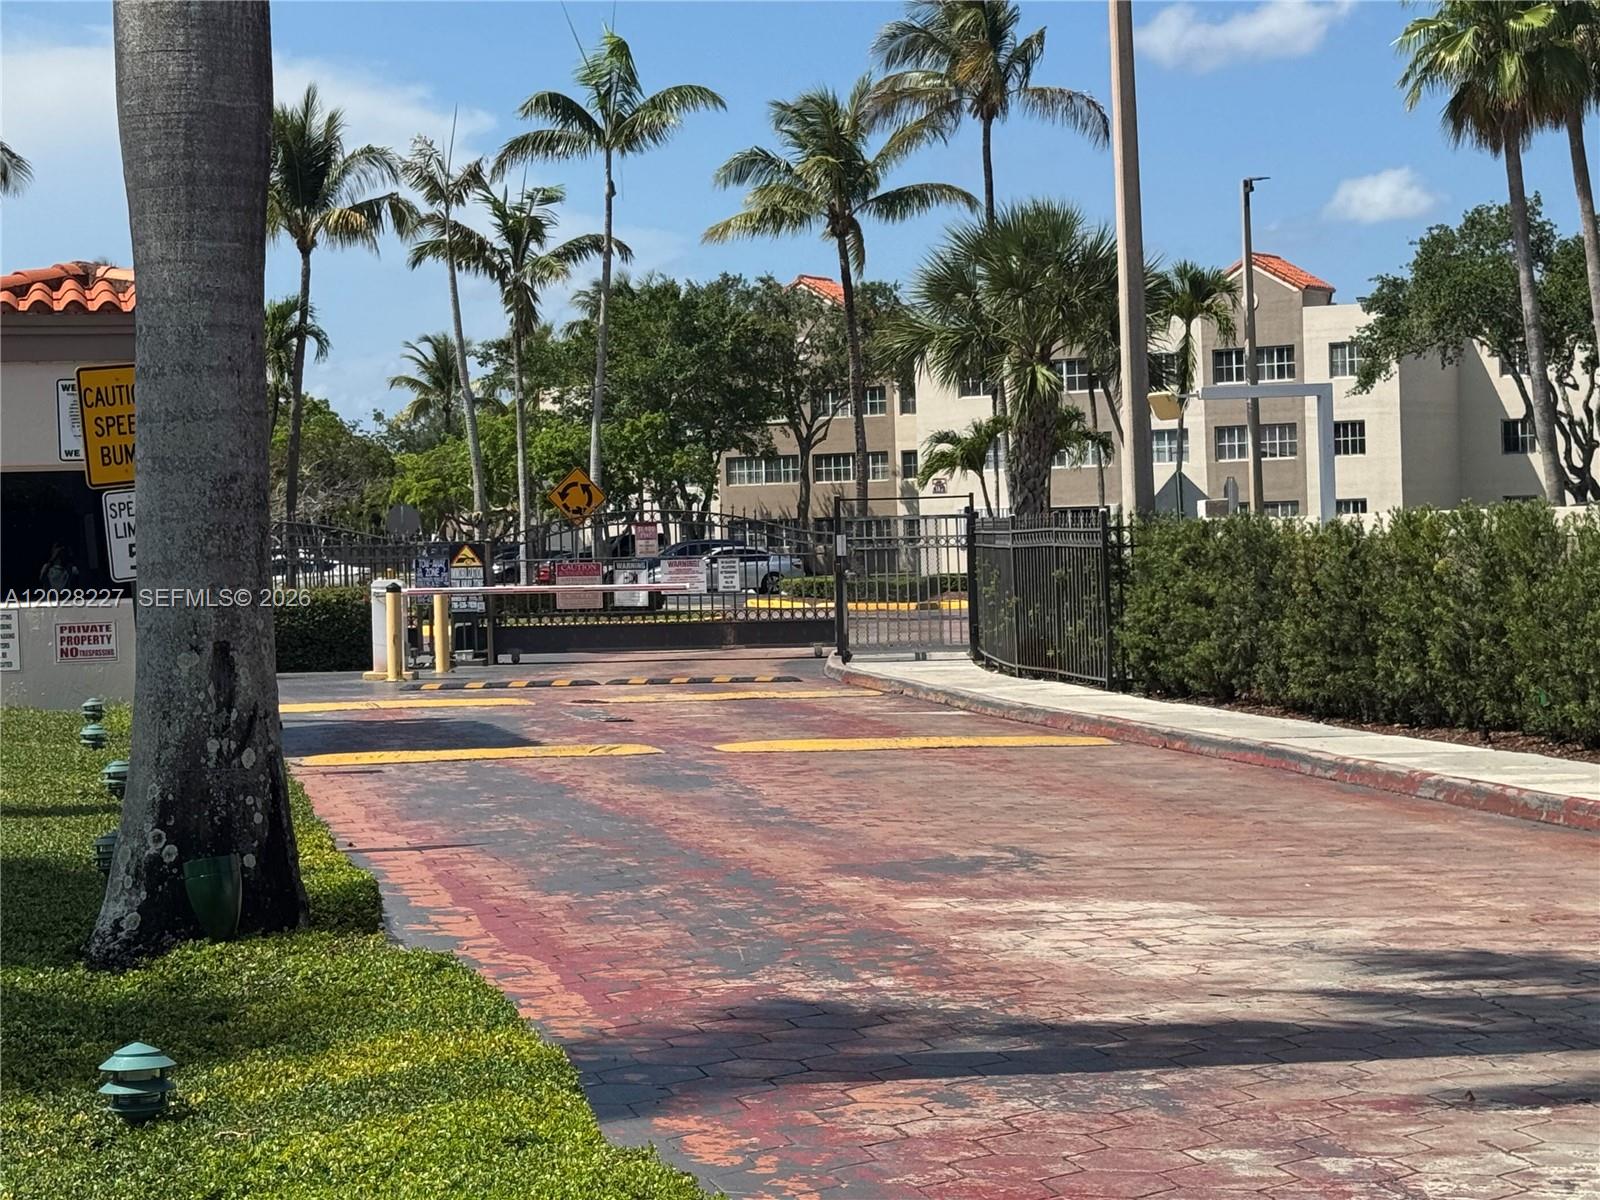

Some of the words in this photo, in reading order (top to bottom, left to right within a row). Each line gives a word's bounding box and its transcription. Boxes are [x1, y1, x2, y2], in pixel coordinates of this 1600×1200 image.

[425, 568, 440, 577] ZONE
[560, 564, 597, 572] CAUTION
[60, 624, 112, 634] PRIVATE
[60, 634, 113, 646] PROPERTY
[60, 647, 79, 658] NO
[79, 648, 115, 657] TRESPASSING
